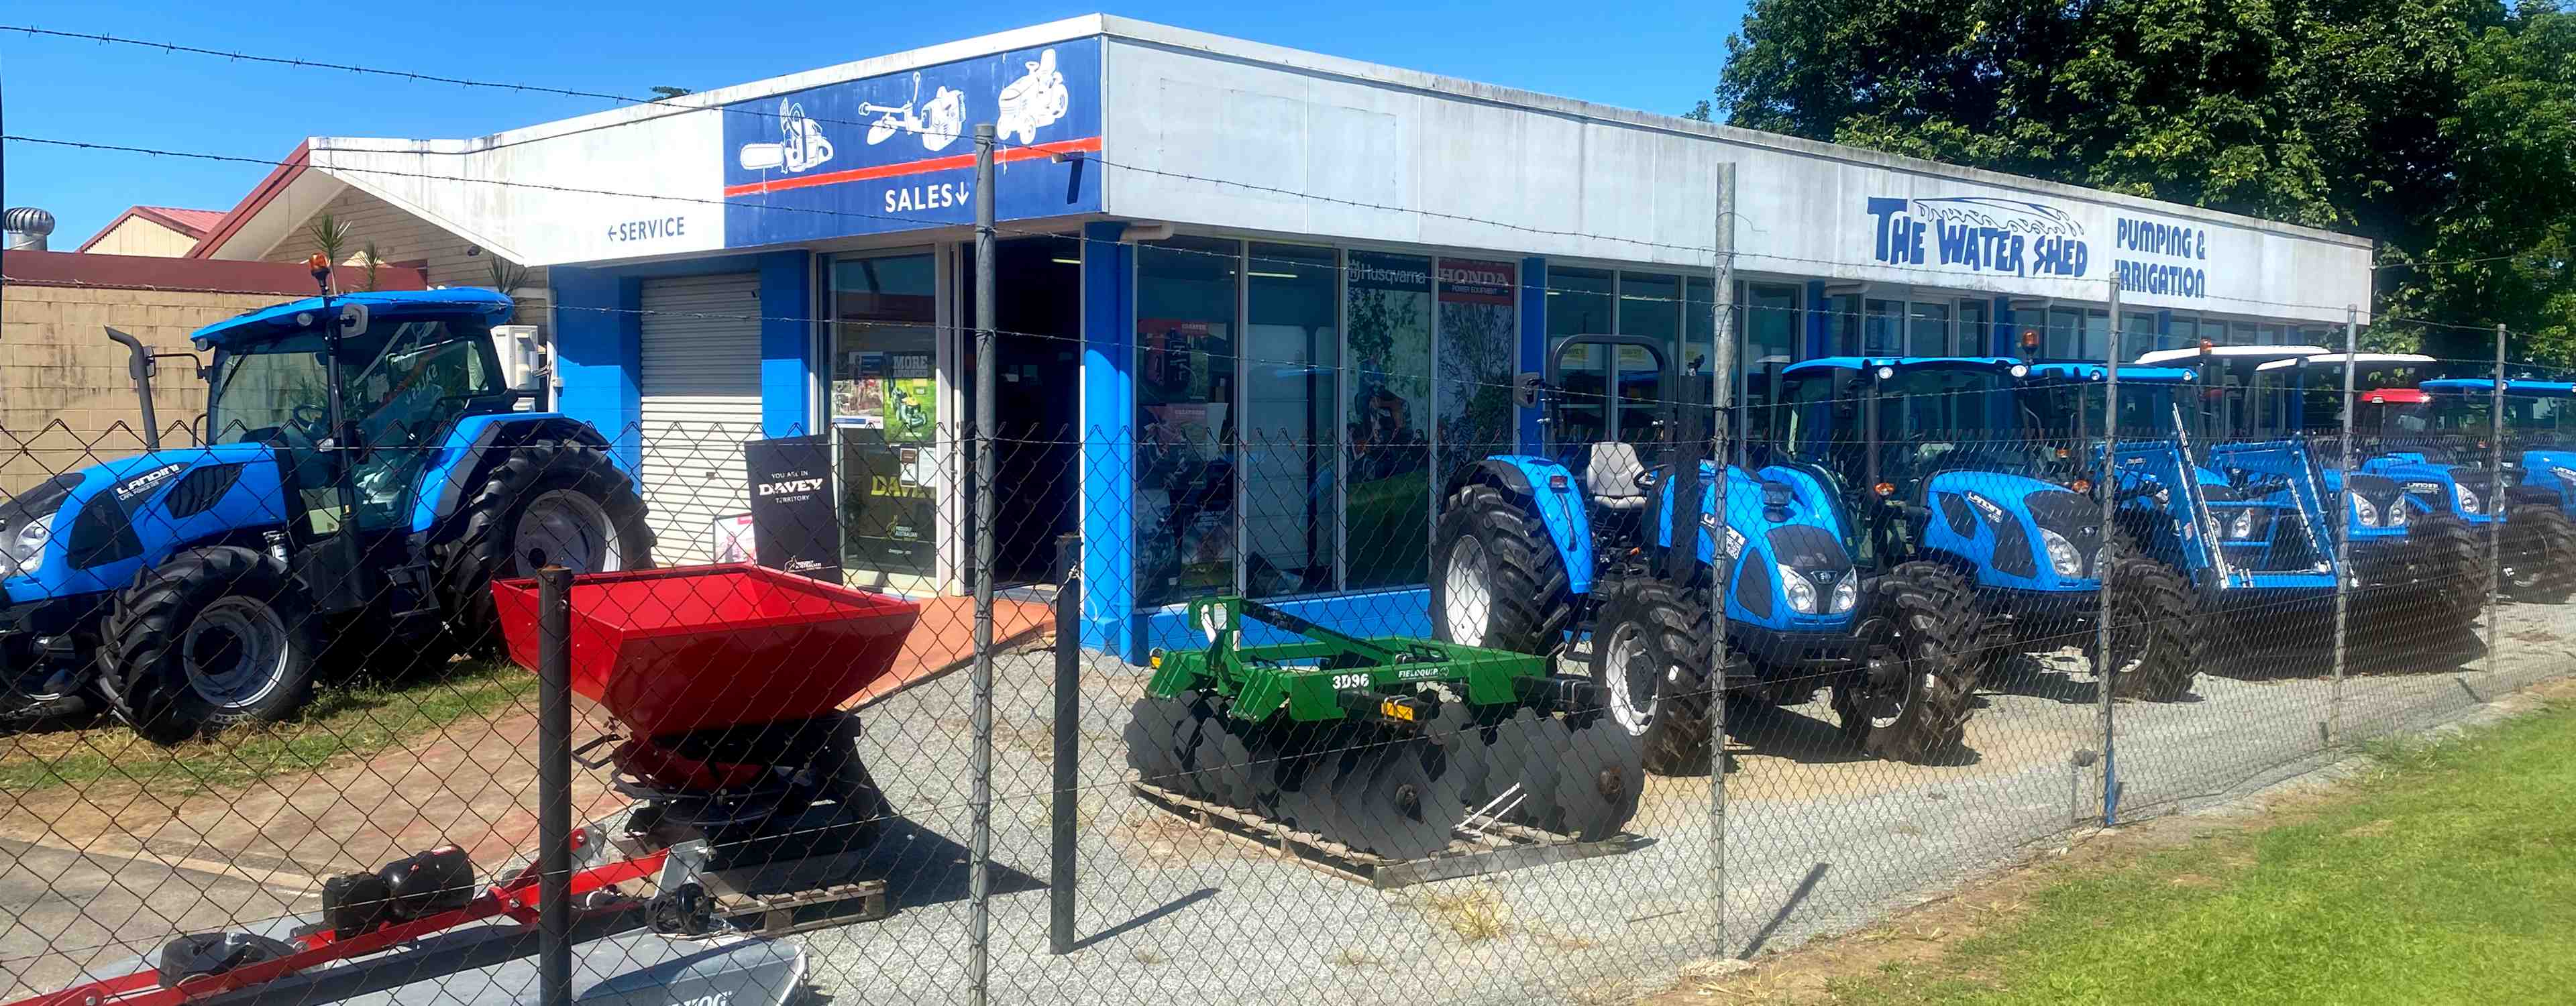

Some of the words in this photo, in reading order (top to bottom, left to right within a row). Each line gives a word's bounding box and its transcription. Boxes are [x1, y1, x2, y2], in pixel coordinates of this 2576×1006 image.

[885, 182, 953, 213] SALES
[619, 217, 685, 242] SERVICE
[1867, 197, 1926, 265] THE
[1936, 218, 2025, 278] WATER
[2033, 235, 2088, 278] SHED
[2116, 217, 2192, 259] PUMPING
[2196, 230, 2206, 260] &
[1361, 264, 1426, 284] Husqvarna
[1438, 268, 1509, 286] HONDA
[893, 355, 928, 370] MORE
[116, 463, 180, 495] LANDINI
[758, 478, 823, 496] DAVEY
[775, 494, 810, 504] TERRITORY
[1332, 673, 1370, 690] 3D96
[1398, 668, 1439, 678] FIELDQUIP
